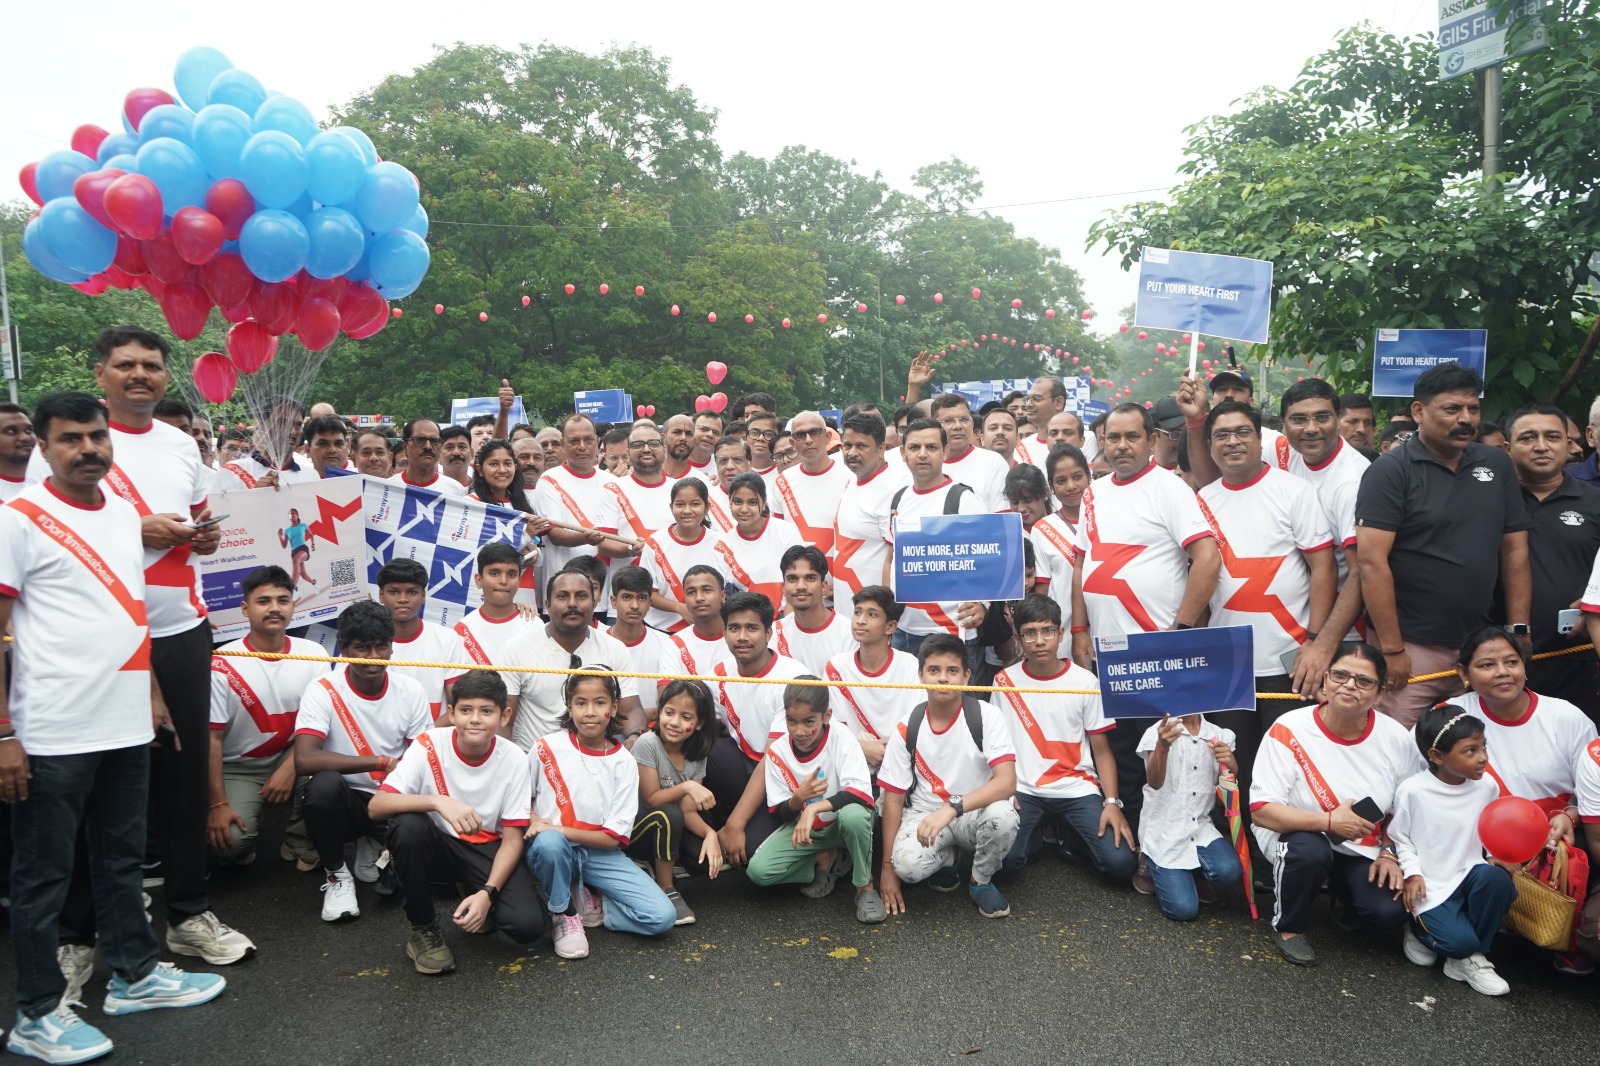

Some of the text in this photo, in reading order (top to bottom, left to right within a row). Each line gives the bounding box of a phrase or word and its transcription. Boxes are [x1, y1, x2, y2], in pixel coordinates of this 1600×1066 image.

[1440, 0, 1541, 48] GIIS Fincial
[1146, 280, 1240, 302] PUT YOUR HEART FIRST
[1380, 356, 1395, 366] PUT
[1395, 357, 1415, 366] YOUR
[1415, 357, 1438, 366] HEART
[376, 485, 389, 520] Narayana
[220, 526, 248, 537] hoice,
[456, 504, 469, 538] Narayana
[37, 513, 115, 587] #Don'tmissabeat
[220, 537, 255, 549] choice
[902, 542, 1001, 558] MOVE MORE, EAT SMART,
[902, 559, 977, 573] LOVE YOUR HEART.
[1107, 656, 1209, 677] ONE HEART. ONE LIFE.
[211, 658, 255, 707] #Don'tmissabeat
[1109, 677, 1164, 692] TAKE CARE.
[328, 688, 367, 751] #Don'tmissabeat
[1289, 738, 1335, 811] #Don'tmissabeat
